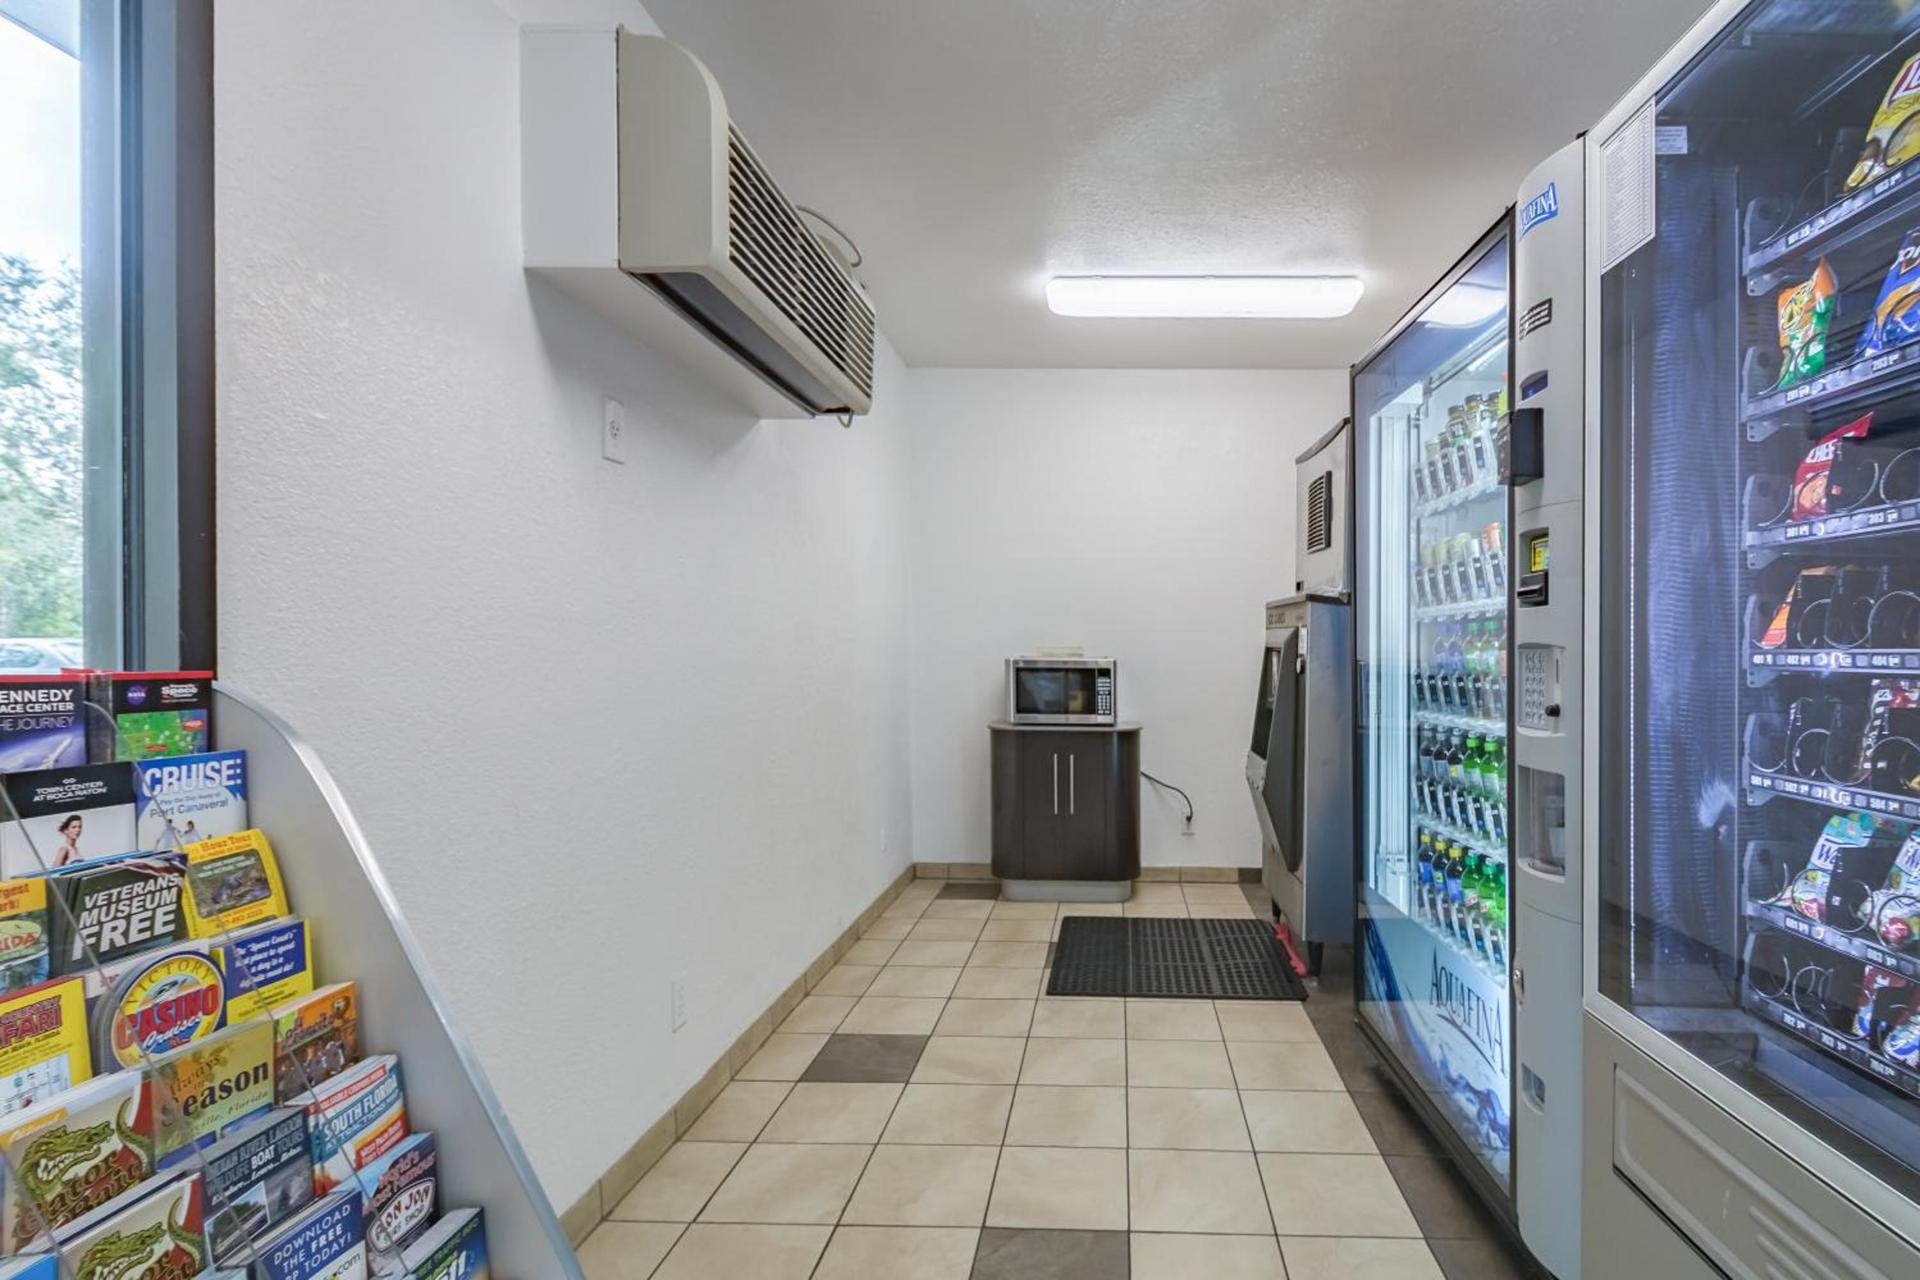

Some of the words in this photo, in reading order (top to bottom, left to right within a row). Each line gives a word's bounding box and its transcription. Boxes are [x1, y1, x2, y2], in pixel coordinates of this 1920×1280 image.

[16, 716, 74, 730] JOURNEY
[26, 702, 75, 713] CENTER
[80, 887, 178, 929] MUSEUM
[84, 872, 181, 909] VETERANS
[72, 904, 177, 961] FREE
[126, 959, 214, 1005] VICTORY
[117, 983, 220, 1050] CASINO
[1430, 948, 1506, 1079] AQUAFINA
[324, 1103, 363, 1140] SOUTH
[251, 1144, 275, 1170] BOAT
[404, 1184, 431, 1211] JON
[274, 1204, 351, 1266] DOWNLOAD
[282, 1249, 306, 1273] THE
[311, 1223, 344, 1252] FREE
[304, 1232, 352, 1273] TODAY!
